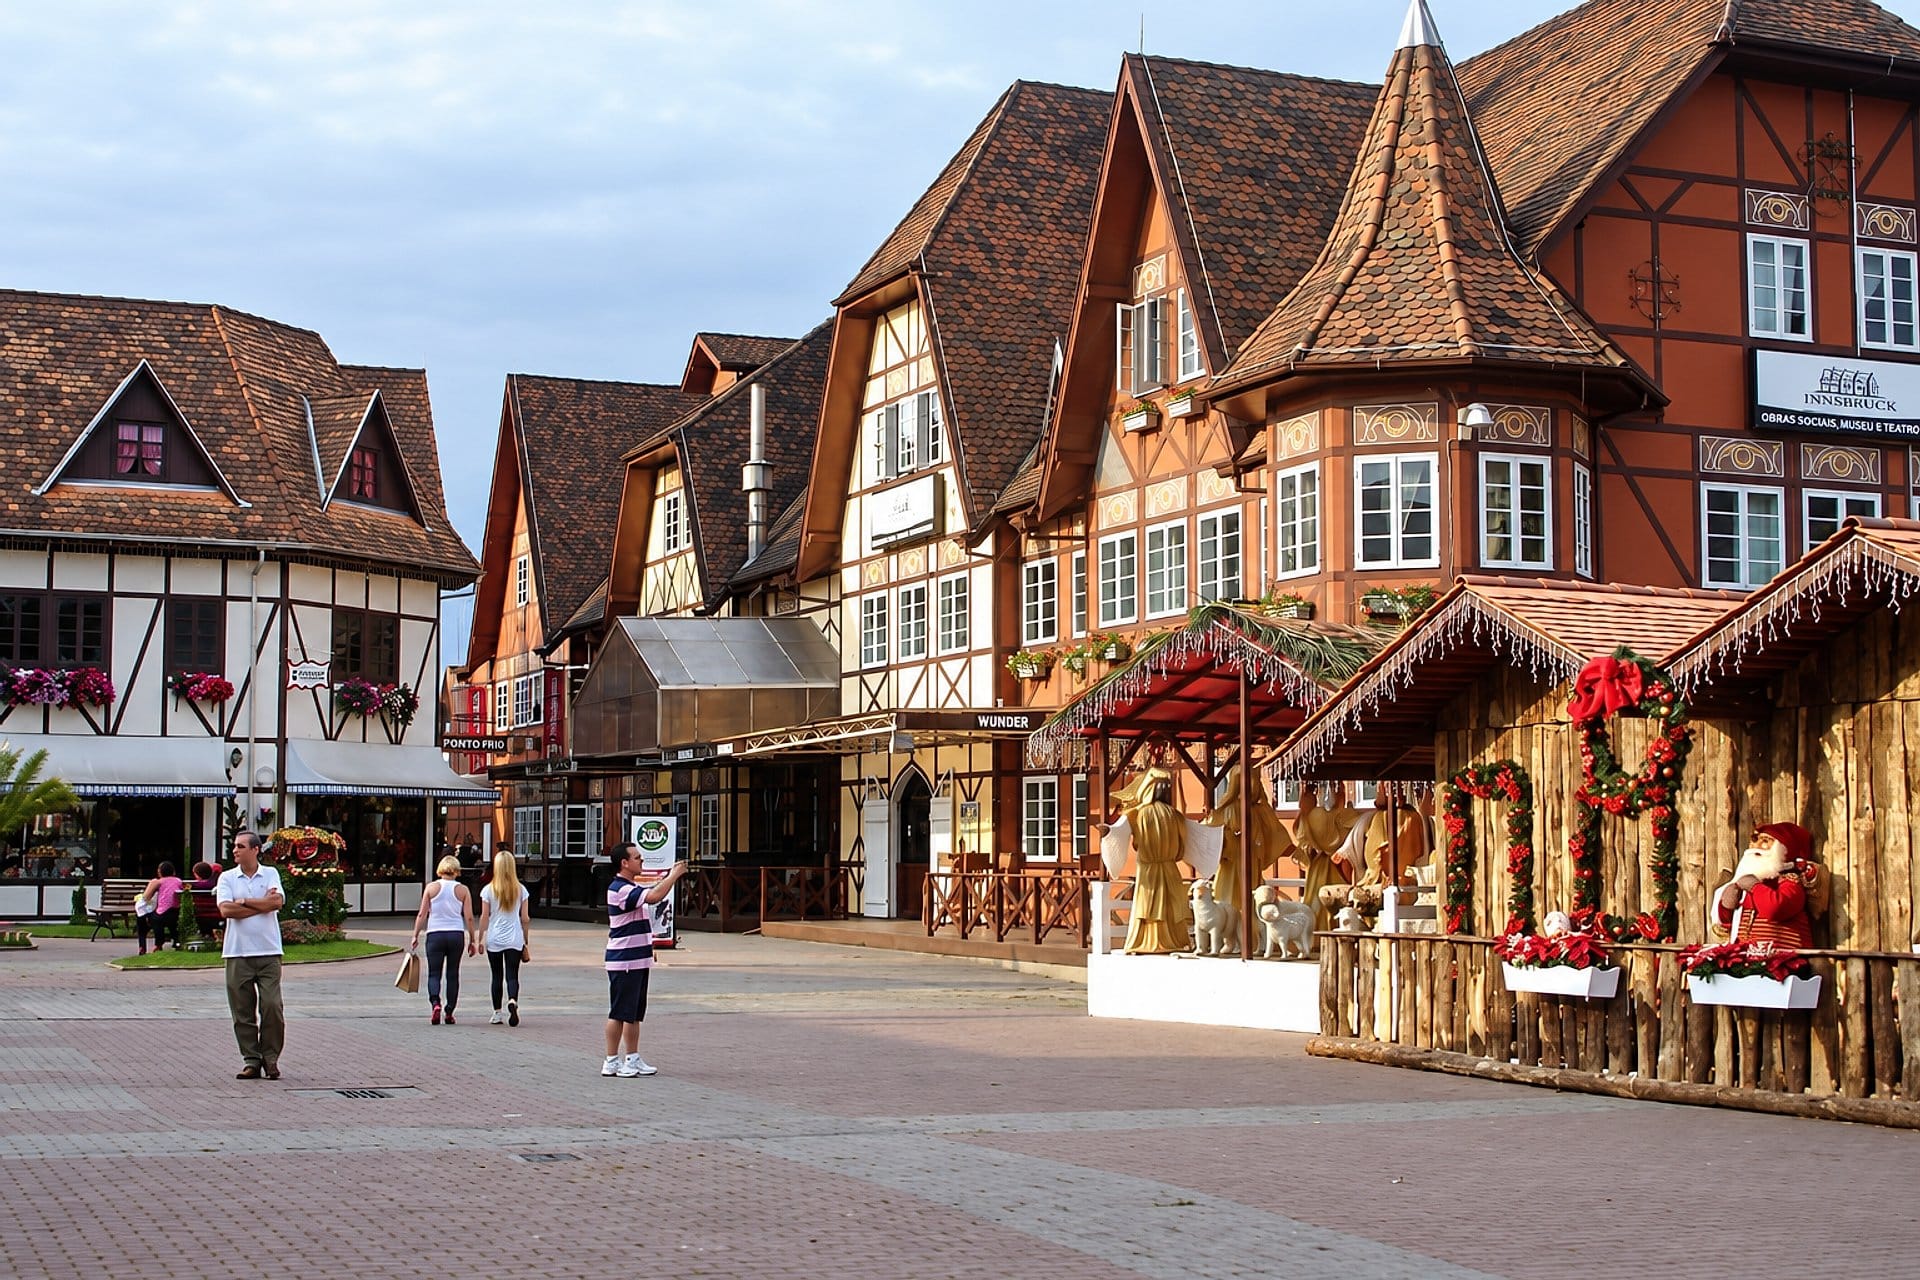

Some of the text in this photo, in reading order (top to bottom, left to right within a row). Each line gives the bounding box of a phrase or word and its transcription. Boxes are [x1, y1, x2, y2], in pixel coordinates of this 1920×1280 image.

[1804, 393, 1897, 412] INNSBRUCK
[1761, 412, 1920, 434] OBRAS SOCIAIS, MUSEU E TEATRO
[977, 715, 1029, 728] WUNDER
[443, 738, 505, 750] PONTO FRIO
